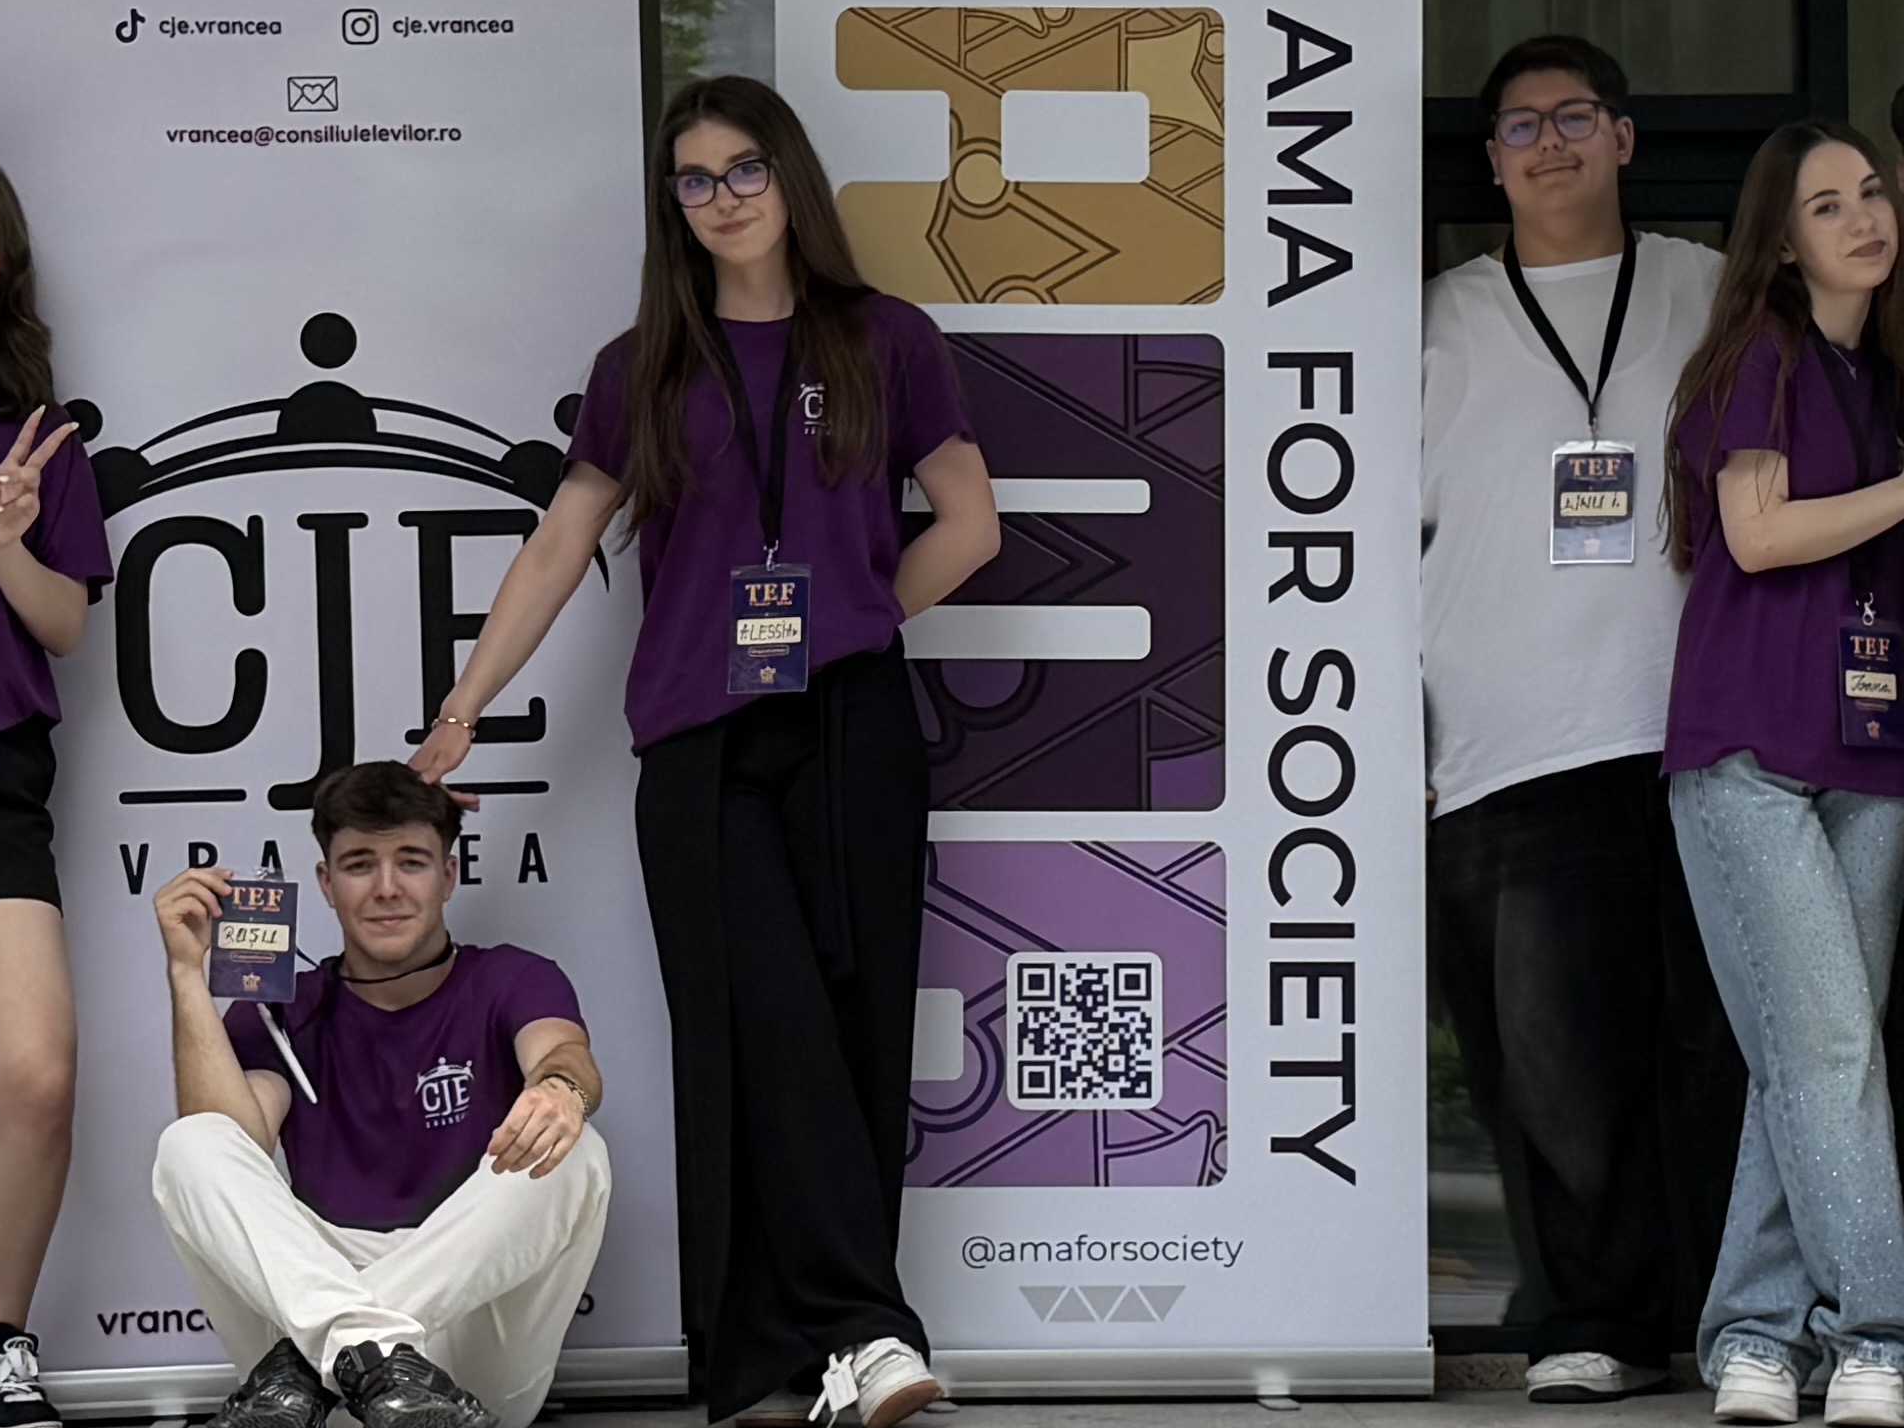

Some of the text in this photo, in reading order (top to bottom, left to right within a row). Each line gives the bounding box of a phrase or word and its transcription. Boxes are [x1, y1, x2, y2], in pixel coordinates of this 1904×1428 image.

[158, 16, 283, 38] cje.vrancea
[391, 16, 515, 38] cje.vrancea
[166, 124, 463, 147] vrancea@consiliulelevilor.ro
[1569, 458, 1622, 477] TEF
[743, 582, 797, 601] TEF
[1265, 7, 1358, 1187] AMA FOR SOCIETY
[1848, 634, 1892, 655] TEF
[114, 508, 548, 811] CJE
[118, 831, 549, 896] VRAEA
[230, 886, 285, 906] TEF
[421, 1074, 471, 1116] CJE
[961, 1233, 1244, 1270] @amaforsociety
